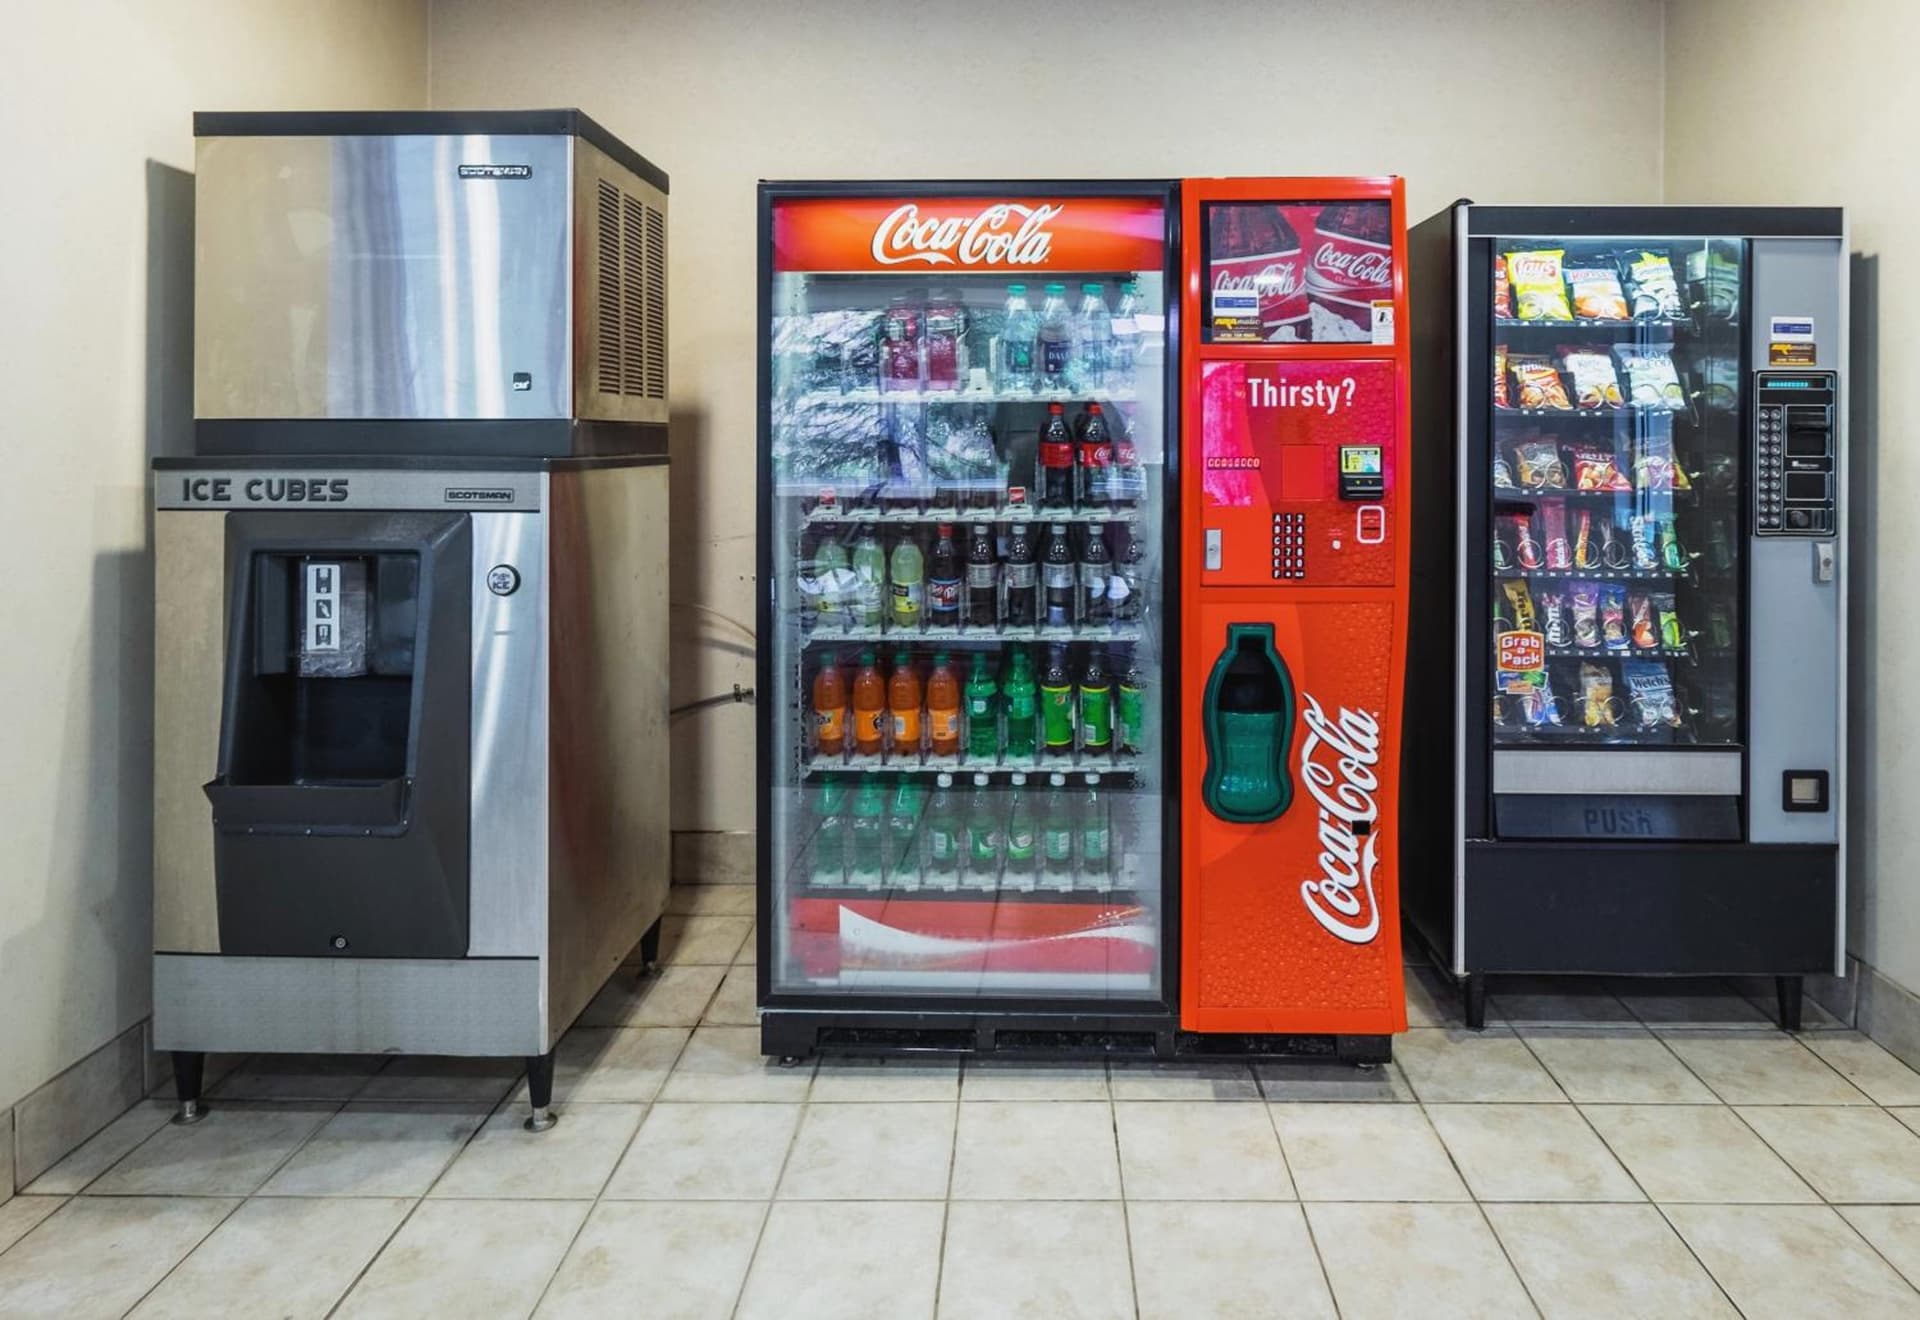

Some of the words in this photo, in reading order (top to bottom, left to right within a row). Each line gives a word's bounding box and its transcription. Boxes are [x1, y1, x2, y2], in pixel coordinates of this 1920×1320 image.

[871, 203, 1064, 265] Coca-Cola
[1247, 377, 1357, 415] Thirsty?
[182, 478, 232, 502] ICE
[245, 478, 349, 502] CUBES
[448, 491, 512, 500] SCOTSMAN
[1502, 636, 1540, 649] Grab
[1517, 647, 1526, 655] a
[1502, 651, 1540, 665] Pack
[1300, 691, 1380, 944] Coca-Cola
[1583, 808, 1654, 834] PUSH
